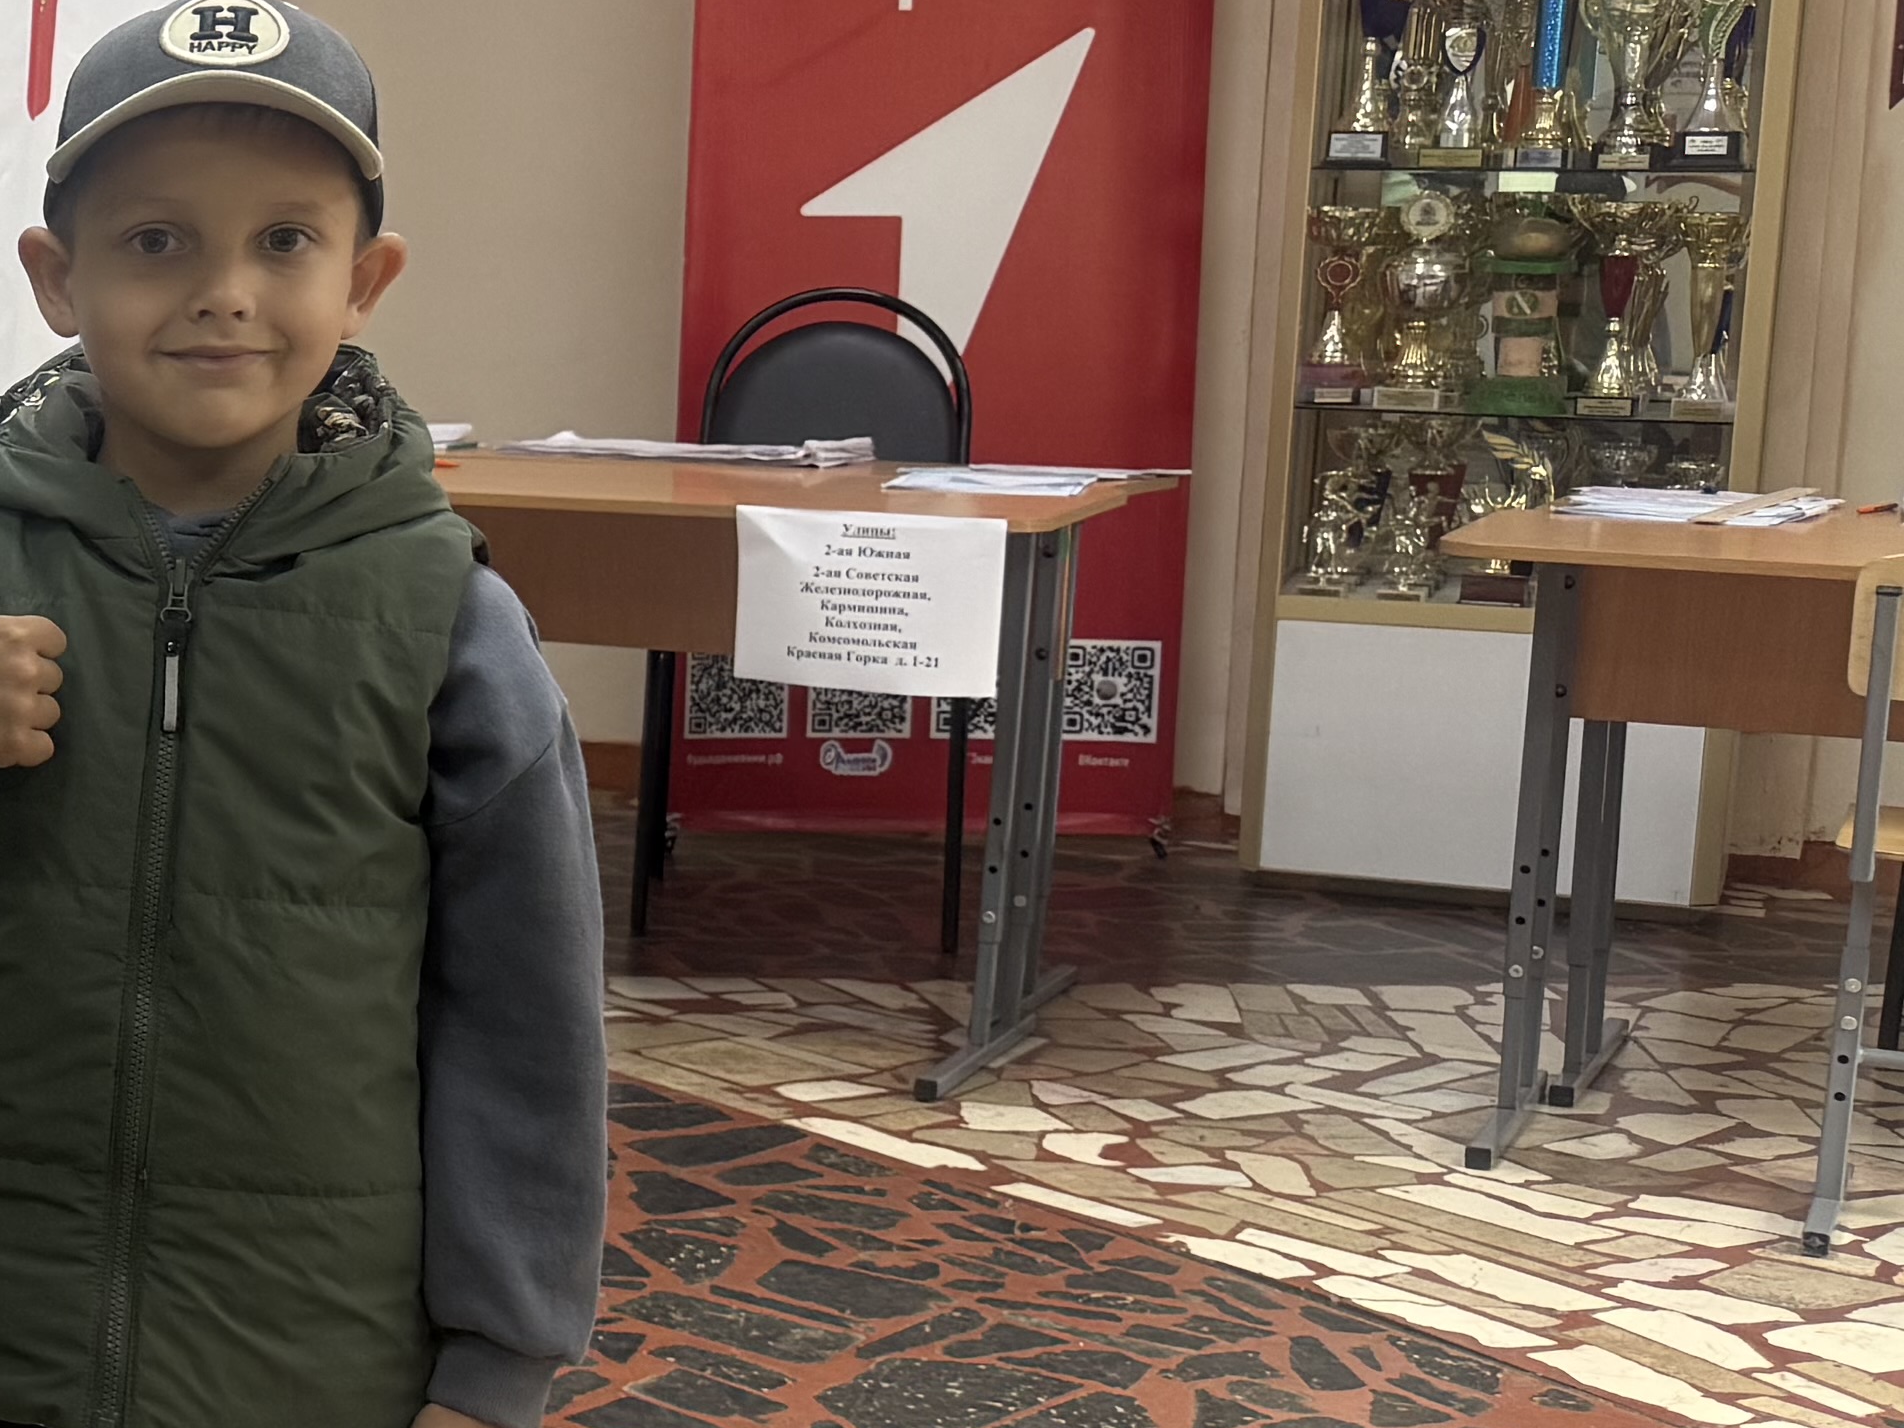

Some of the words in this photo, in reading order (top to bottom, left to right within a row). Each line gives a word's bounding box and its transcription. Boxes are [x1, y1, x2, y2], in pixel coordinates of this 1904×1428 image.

[190, 5, 259, 42] H
[189, 41, 257, 54] HAPPY
[858, 547, 911, 560] Южная
[845, 568, 919, 583] Советская
[809, 633, 917, 650] Комсомольская
[787, 647, 842, 661] Красная
[846, 652, 888, 666] Горка
